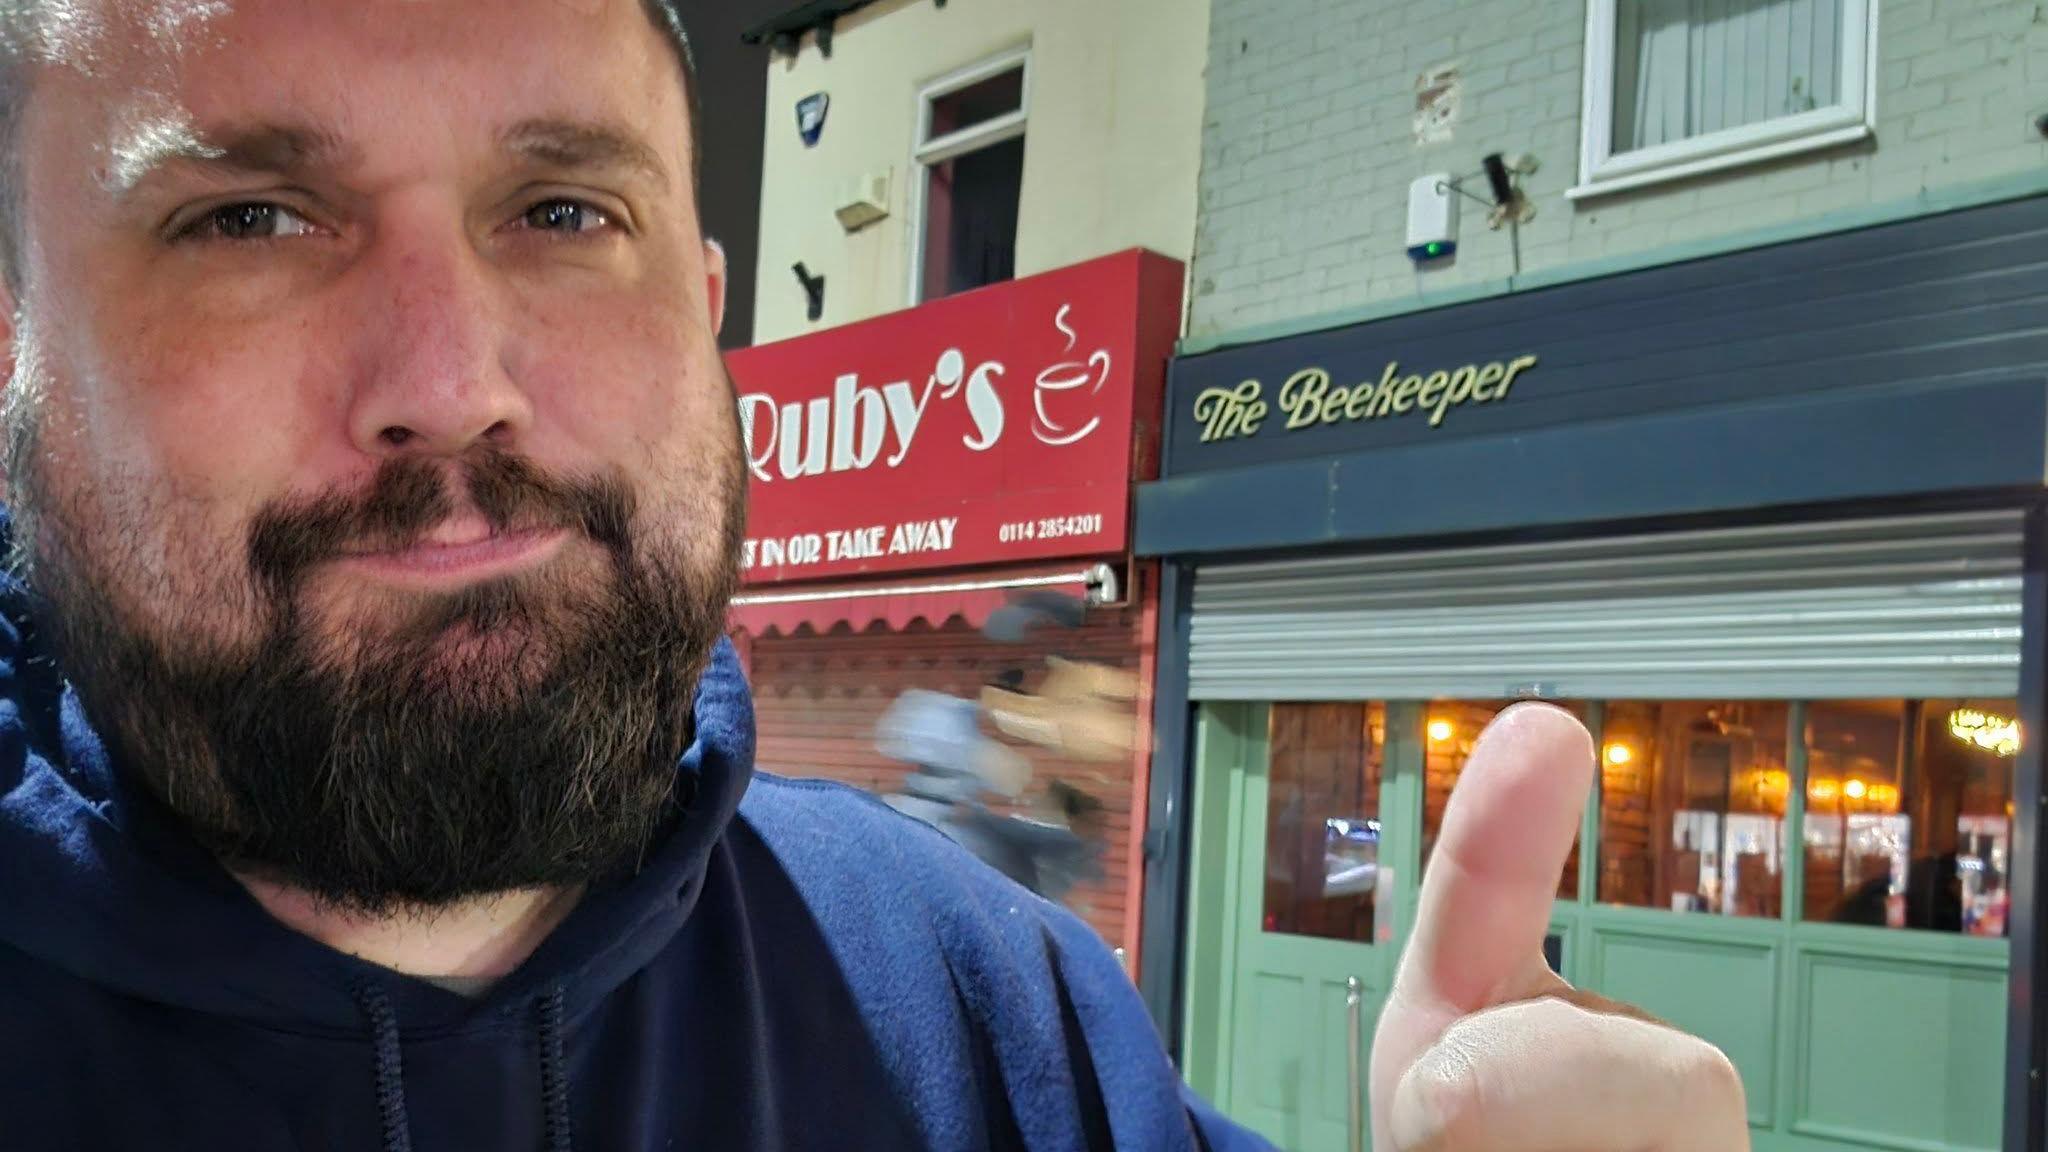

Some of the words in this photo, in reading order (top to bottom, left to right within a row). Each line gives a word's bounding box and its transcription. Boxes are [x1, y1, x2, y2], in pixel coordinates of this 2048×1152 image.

[738, 348, 1006, 481] Ruby's
[1194, 379, 1268, 443] The
[1279, 354, 1537, 429] Beekeeper
[761, 537, 785, 567] IN
[787, 532, 822, 565] OR
[824, 525, 887, 561] TAKE
[887, 516, 958, 555] AWAY
[999, 519, 1035, 542] 0114
[1037, 513, 1103, 539] 2854201
